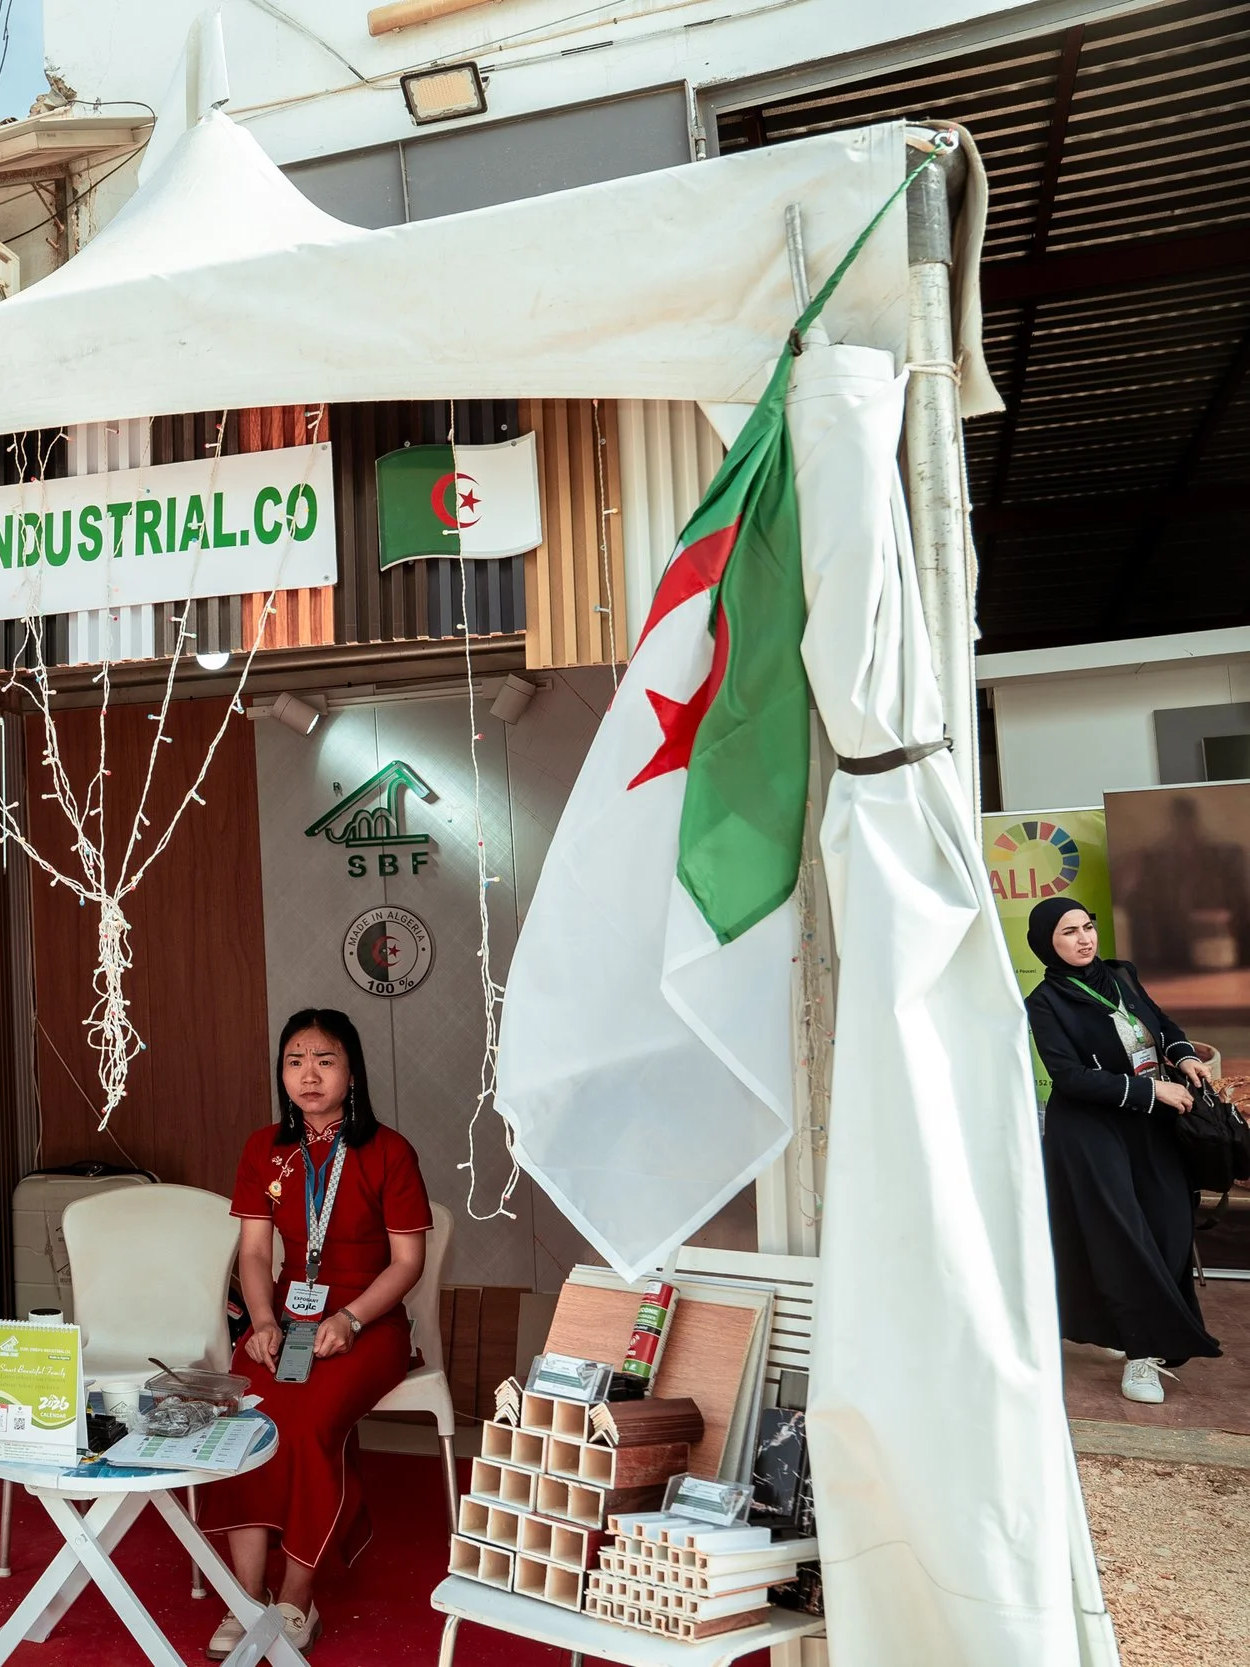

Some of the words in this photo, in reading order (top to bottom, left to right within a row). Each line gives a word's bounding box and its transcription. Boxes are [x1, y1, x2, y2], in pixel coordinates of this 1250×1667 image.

[348, 918, 371, 946] MADE
[371, 911, 383, 922] IN
[387, 911, 425, 943] ALGERIA
[367, 980, 395, 994] 100
[291, 1301, 317, 1311] عارض
[38, 1394, 70, 1411] 2026
[40, 1411, 67, 1419] CALENDAR
